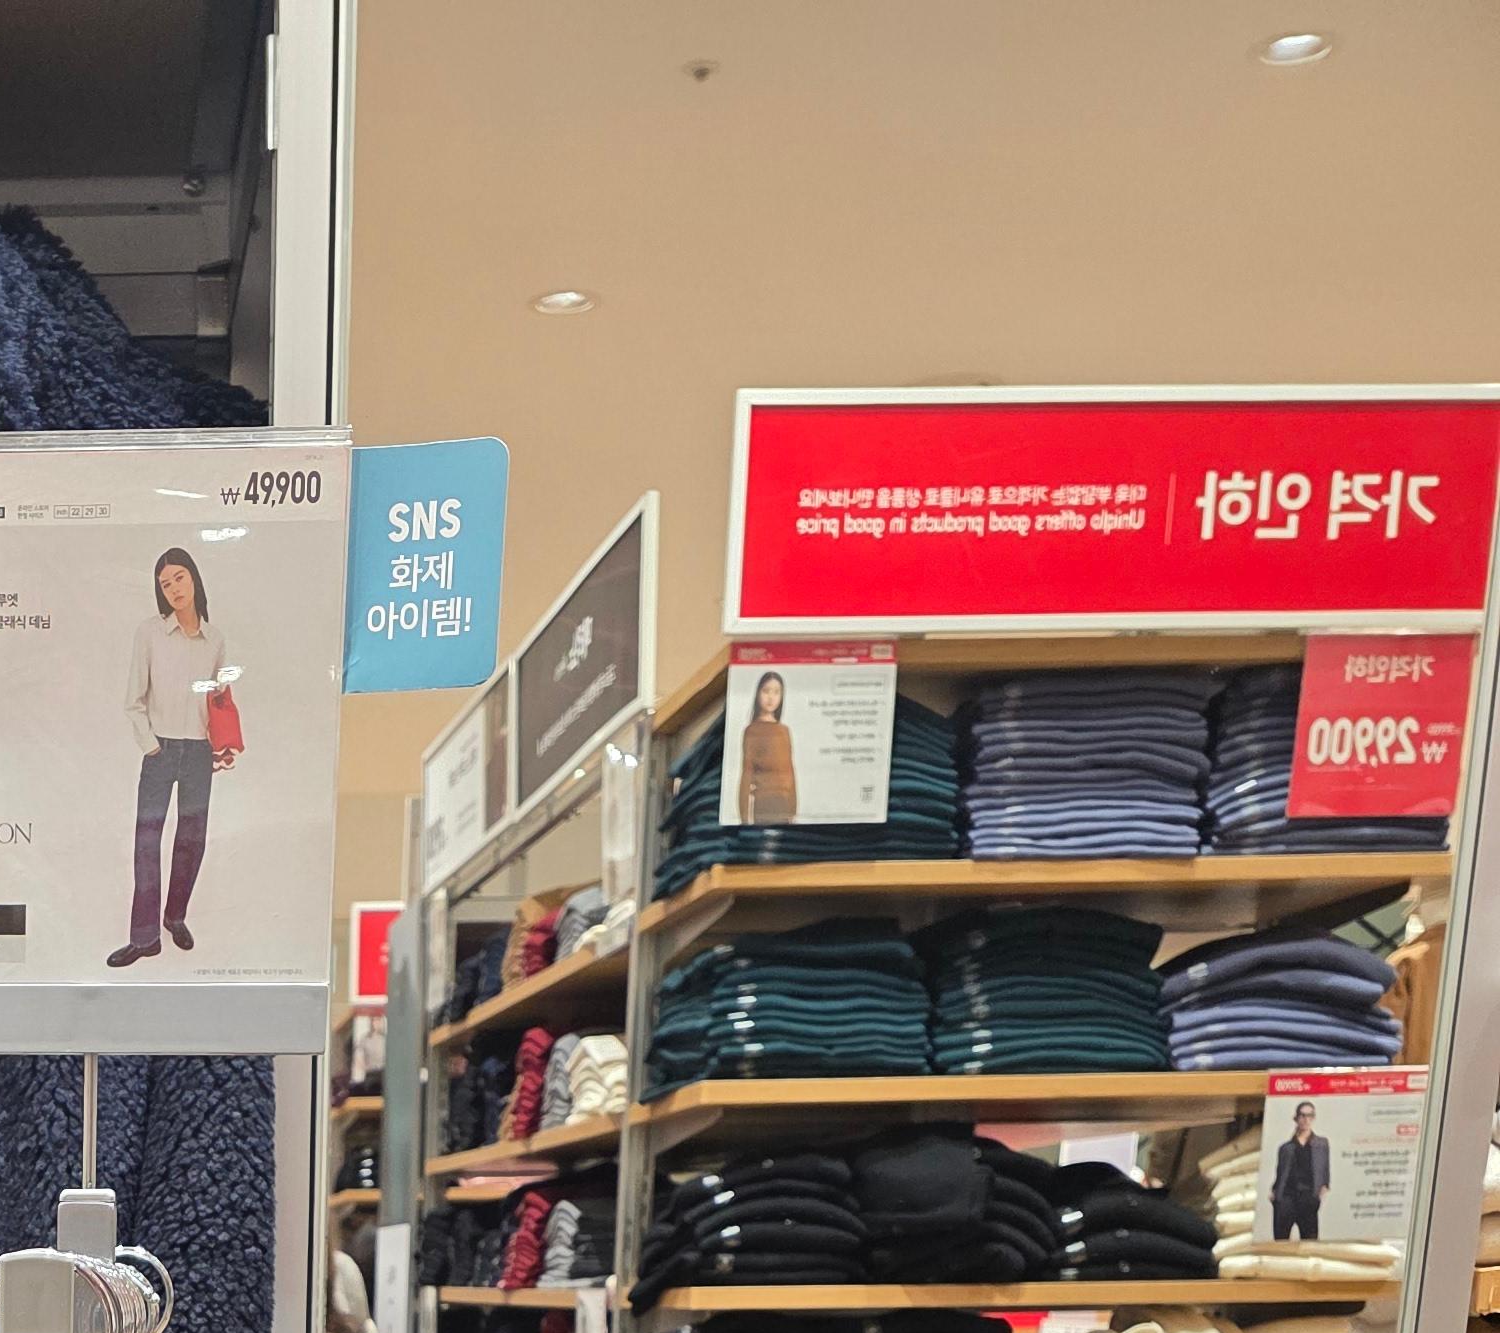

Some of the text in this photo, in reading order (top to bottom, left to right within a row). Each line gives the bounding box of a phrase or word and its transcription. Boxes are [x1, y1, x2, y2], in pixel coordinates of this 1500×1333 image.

[71, 507, 80, 516] 22
[85, 507, 94, 516] 29
[98, 507, 108, 515] 30
[387, 498, 462, 543] SNS
[388, 551, 454, 592] 화제
[29, 615, 51, 629] 데님
[367, 597, 472, 640] 아이템!
